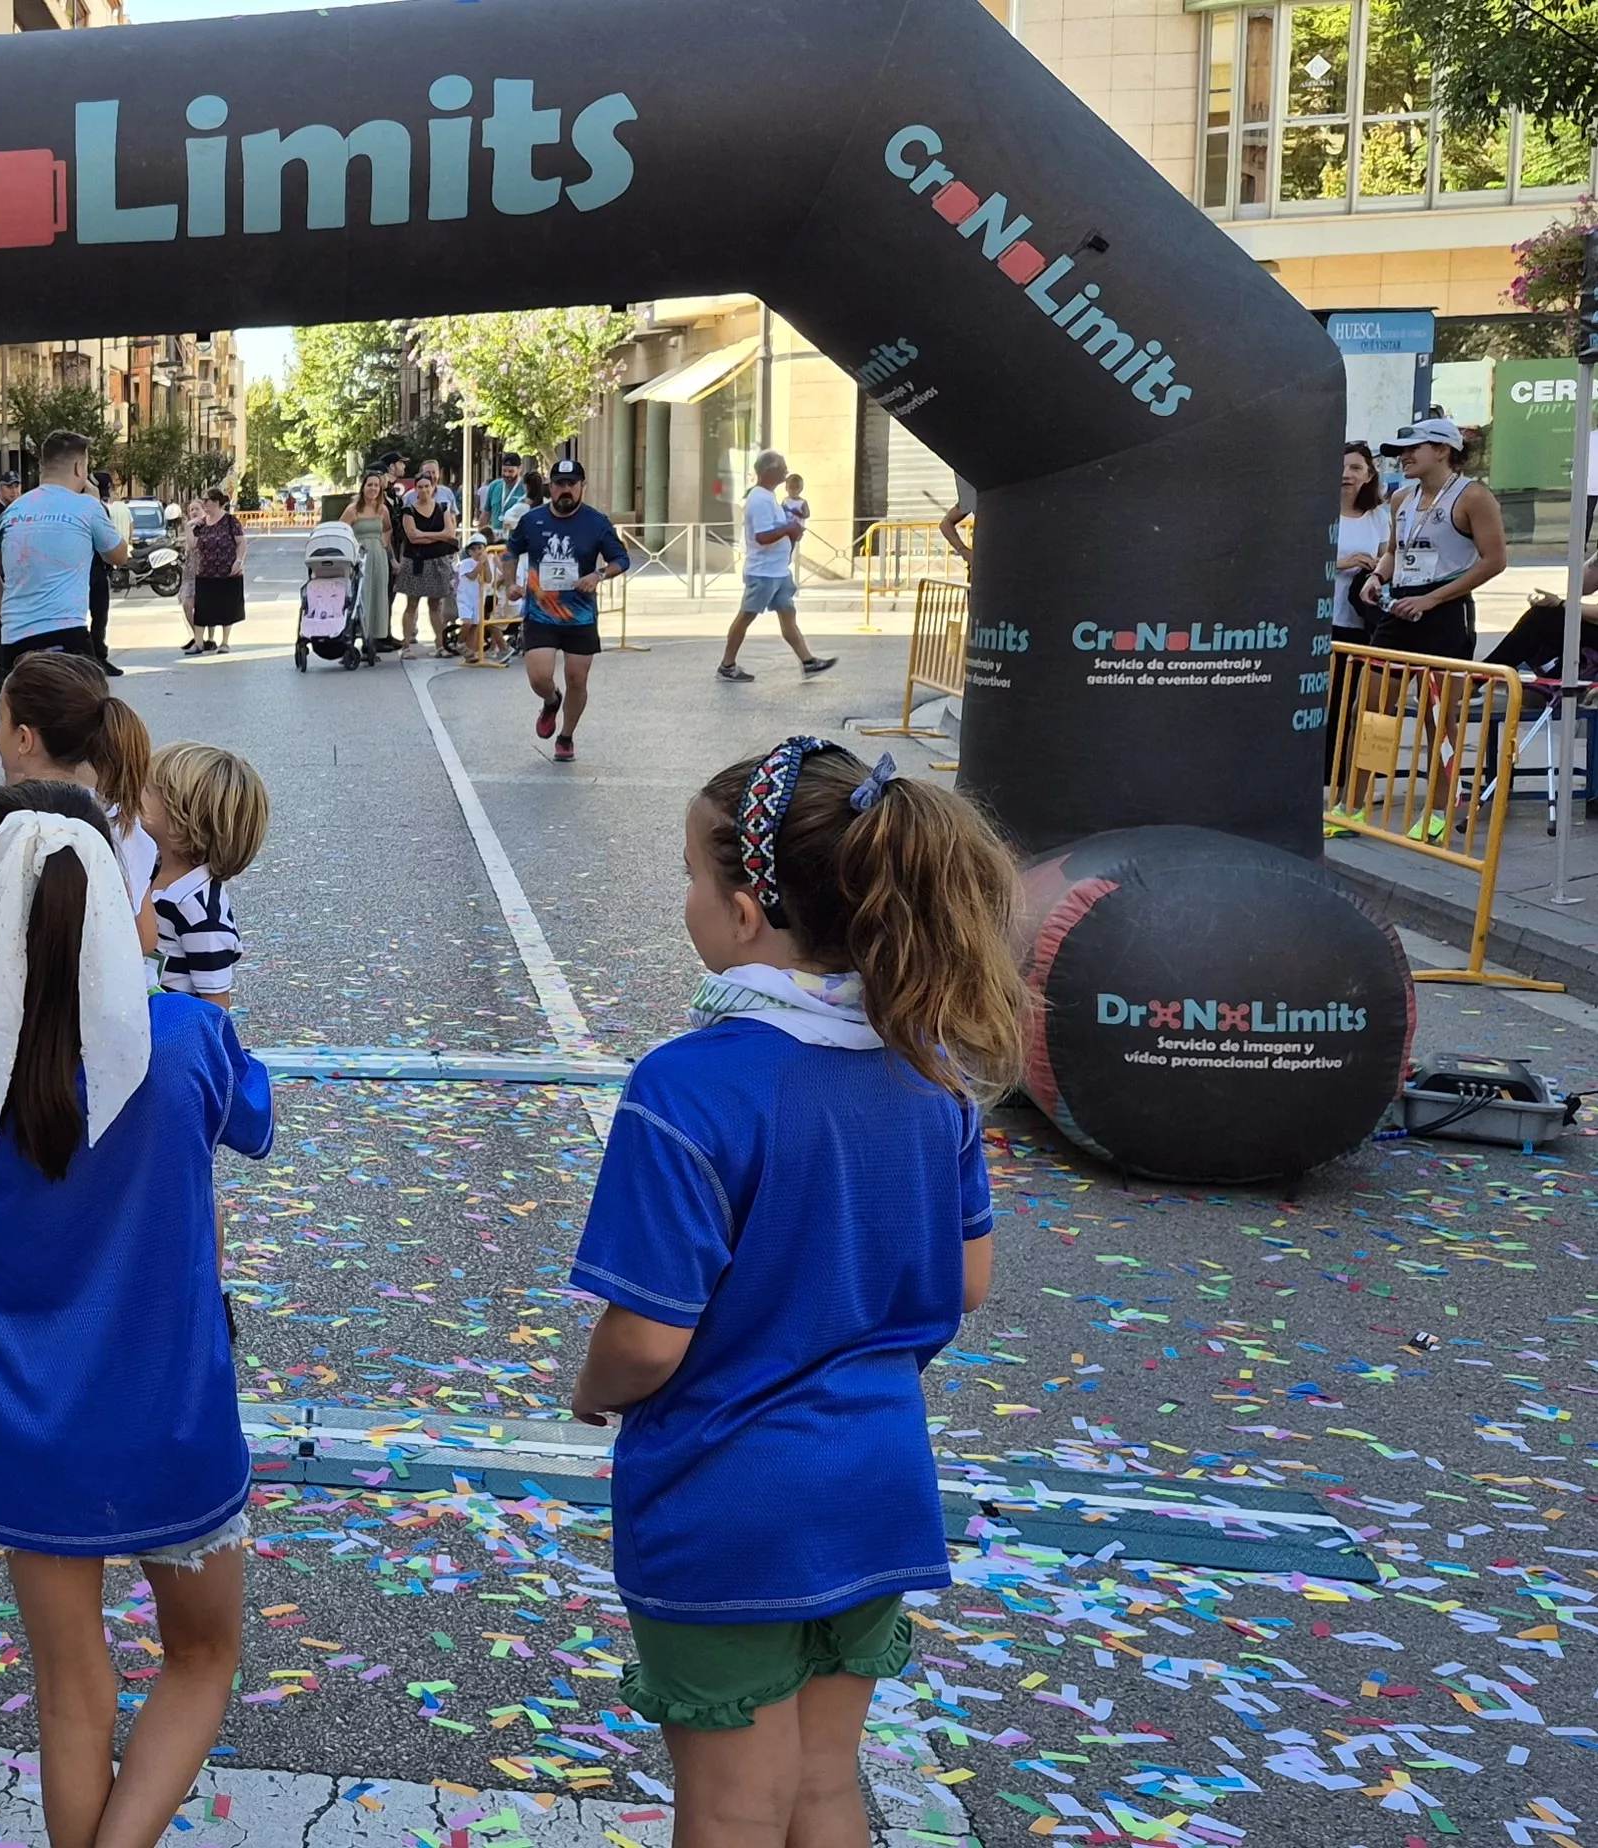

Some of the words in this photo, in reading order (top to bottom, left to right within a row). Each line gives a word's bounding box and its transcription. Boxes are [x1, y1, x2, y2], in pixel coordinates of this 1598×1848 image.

[1335, 322, 1382, 340] HUESCA
[1526, 402, 1562, 421] por
[1405, 554, 1416, 566] 9
[551, 567, 566, 576] 72
[968, 617, 1030, 653] Limits
[1094, 657, 1144, 671] Servicio
[1146, 657, 1165, 671] de
[1166, 657, 1252, 671] cronometraje
[1253, 658, 1262, 671] y
[1086, 672, 1134, 686] gestión
[1134, 673, 1155, 686] de
[1156, 674, 1208, 686] eventos
[1210, 672, 1272, 686] deportivos
[1298, 670, 1330, 694] TROF
[1291, 707, 1323, 732] CHIP
[1157, 1035, 1217, 1053] Servicio
[1218, 1039, 1240, 1053] de
[1243, 1040, 1302, 1054] imagen
[1303, 1041, 1315, 1056] y
[1124, 1050, 1168, 1066] vídeo
[1170, 1054, 1269, 1070] promocional
[1271, 1055, 1343, 1072] deportivo
